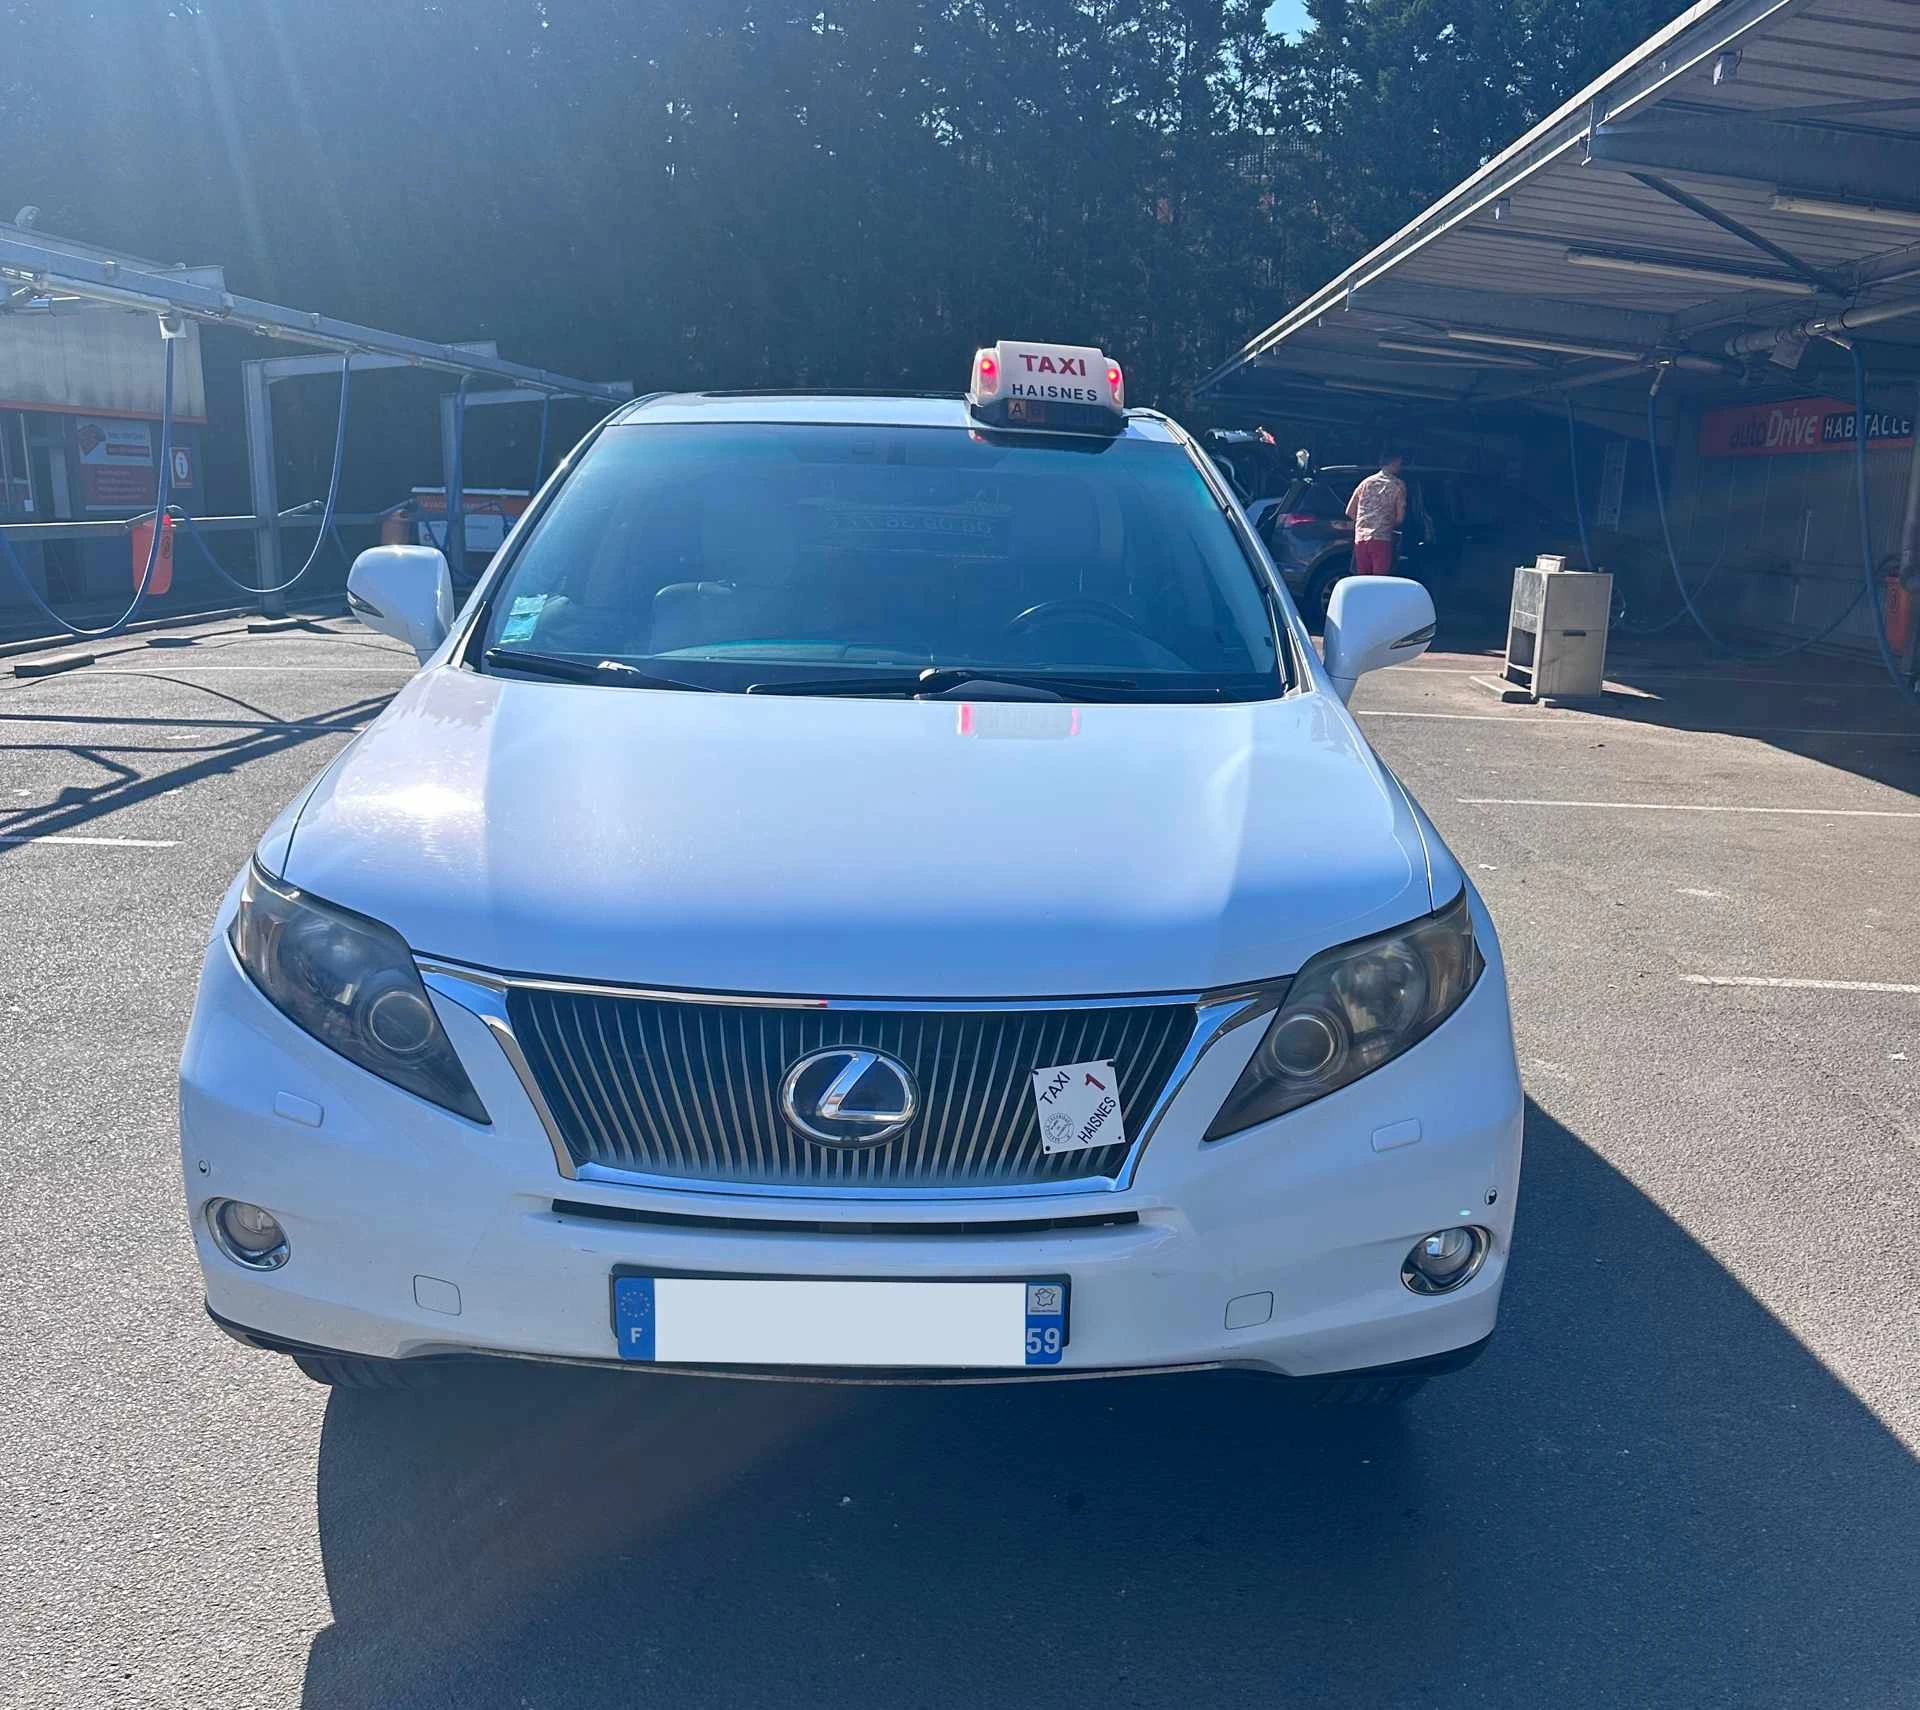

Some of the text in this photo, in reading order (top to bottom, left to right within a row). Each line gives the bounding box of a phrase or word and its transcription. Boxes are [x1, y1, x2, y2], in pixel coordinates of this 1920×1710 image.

[1018, 354, 1086, 377] TAXI
[1011, 383, 1098, 402] HAISNES
[1011, 402, 1023, 415] A
[1823, 413, 1912, 439] HABTACLE
[1039, 1071, 1071, 1105] TAXI
[1084, 1072, 1106, 1091] 1
[1077, 1096, 1117, 1144] HAISNES
[630, 1327, 643, 1344] F
[1026, 1327, 1060, 1355] 59
